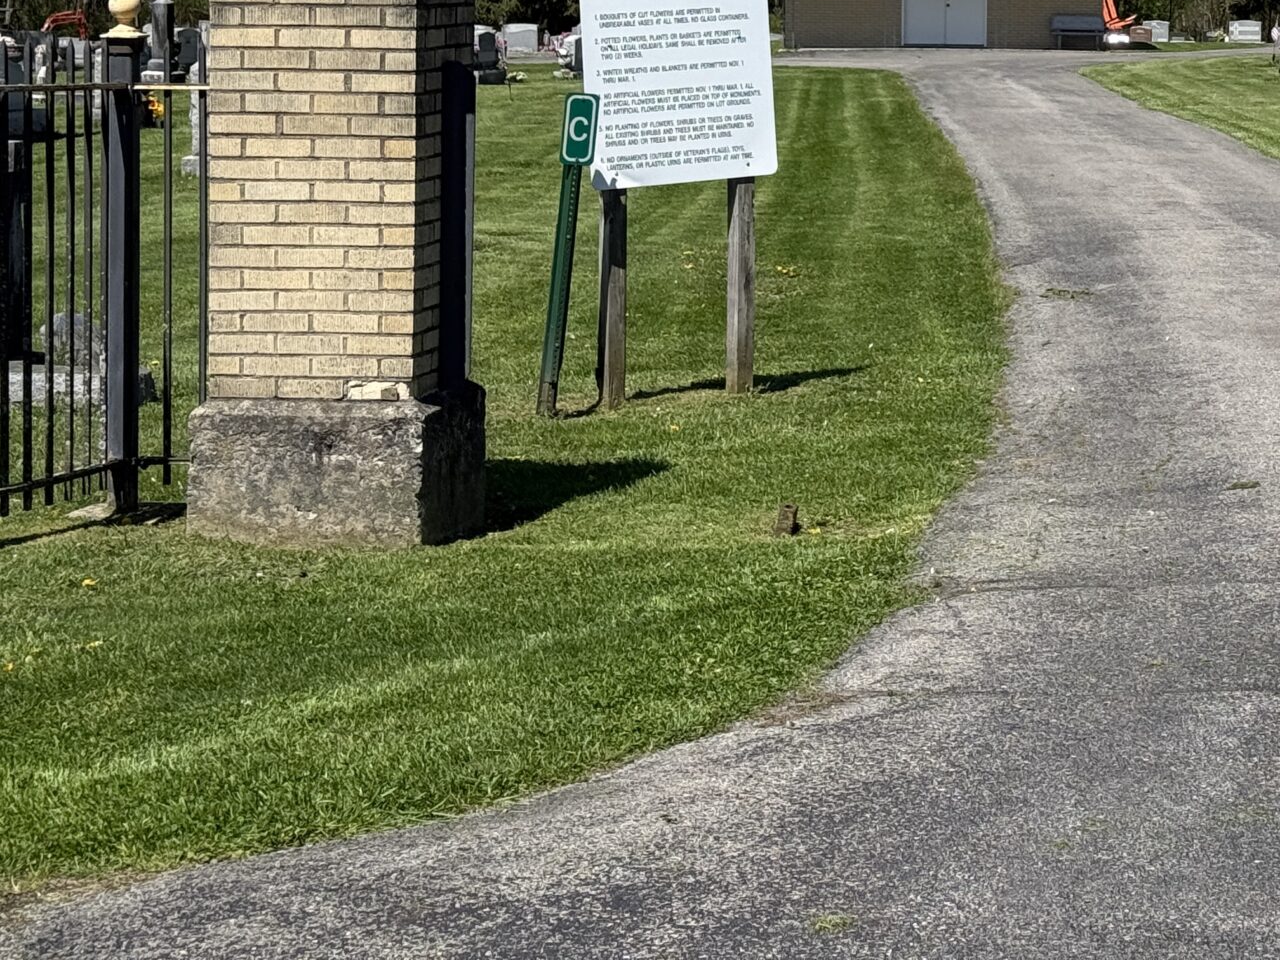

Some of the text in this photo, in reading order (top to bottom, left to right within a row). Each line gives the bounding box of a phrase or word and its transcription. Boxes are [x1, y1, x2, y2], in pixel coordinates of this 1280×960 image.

[599, 20, 635, 29] UNBREAKABLE
[718, 13, 749, 21] CONTAINERS.
[714, 29, 741, 37] PERMITTED
[662, 64, 687, 72] BLANKETS
[700, 61, 727, 69] PERMITTED
[613, 91, 639, 99] ARTIFICIAL
[641, 89, 665, 97] FLOWERS
[667, 87, 694, 95] PERMITTED
[613, 107, 639, 115] ARTIFICIAL
[678, 102, 705, 110] PERMITTED
[677, 118, 697, 126] SHRUBS
[569, 117, 588, 141] C
[616, 131, 639, 139] EXISTING
[607, 163, 634, 171] LANTERNS,
[645, 160, 665, 168] PLASTIC
[694, 155, 721, 163] PERMITTED
[616, 154, 648, 162] ORNAMENTS
